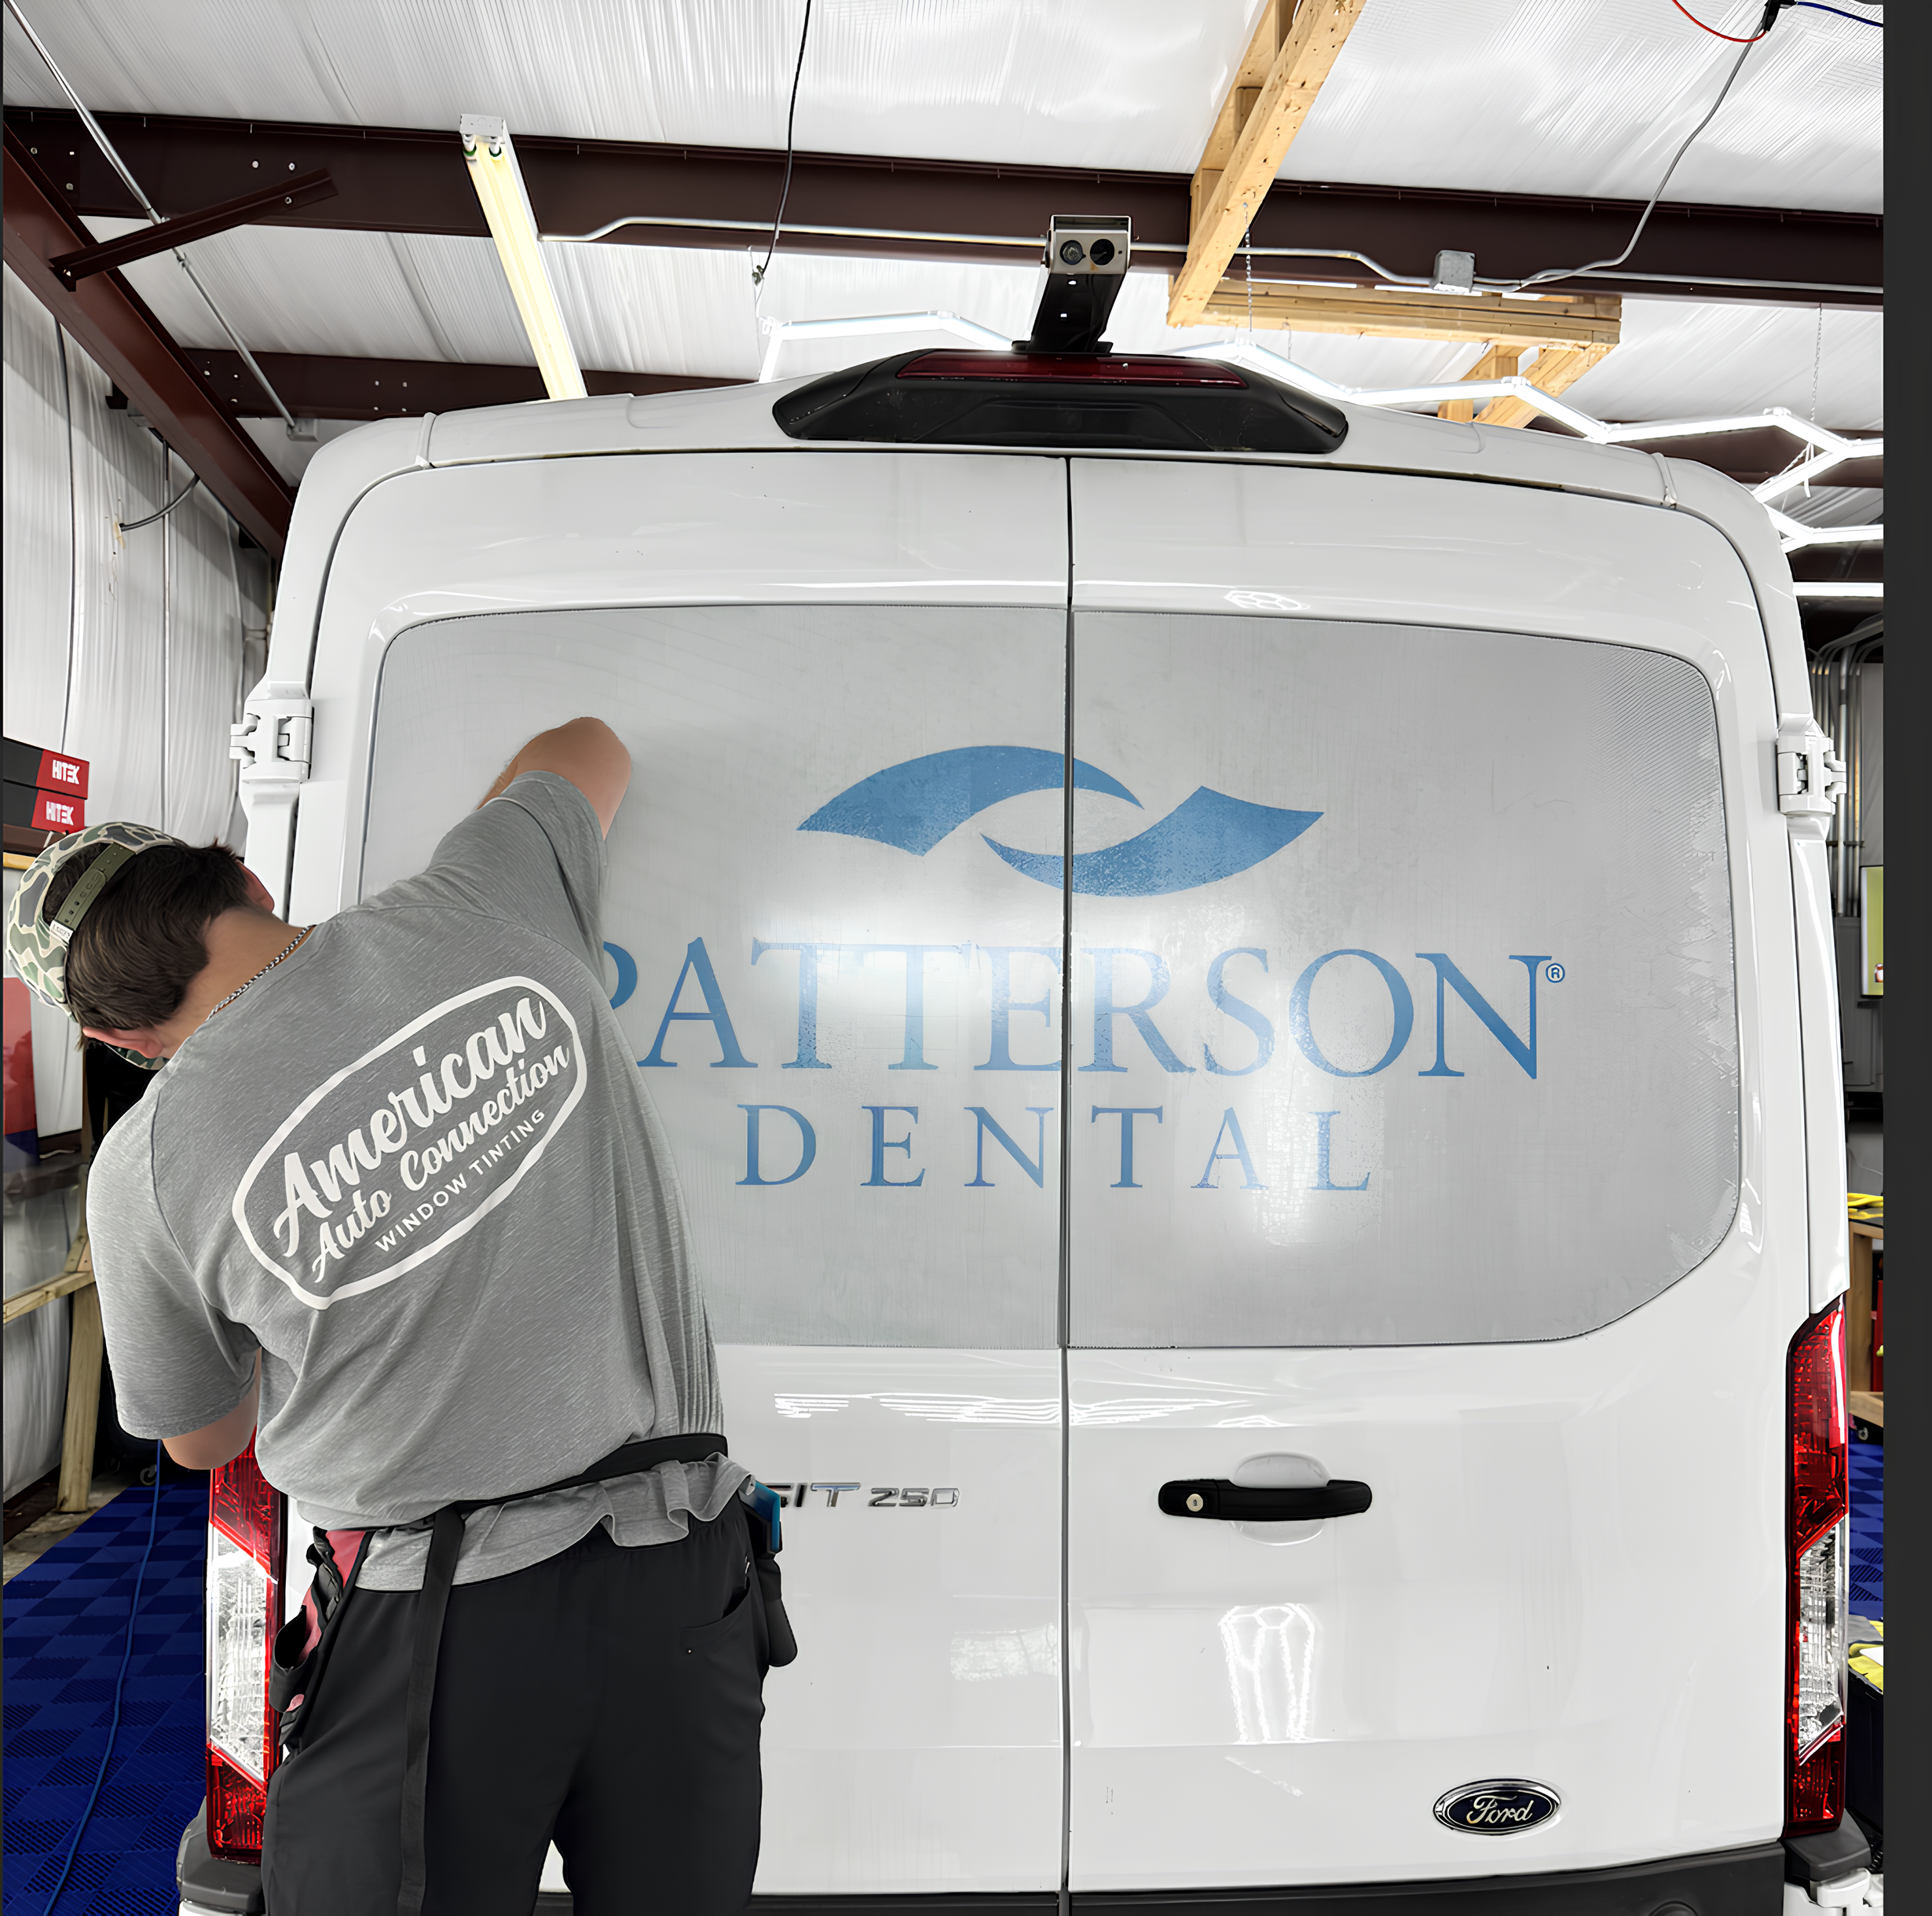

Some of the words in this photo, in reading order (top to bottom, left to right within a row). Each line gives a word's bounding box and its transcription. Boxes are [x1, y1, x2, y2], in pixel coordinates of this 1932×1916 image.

[52, 759, 80, 784] HITEK
[46, 800, 75, 826] HITEK
[273, 997, 547, 1258] American
[735, 1103, 1371, 1191] DENTAL
[311, 1189, 392, 1284] Auto
[400, 1044, 570, 1191] Connection
[375, 1173, 467, 1252] WINDOW
[469, 1109, 546, 1176] TINTING
[868, 1487, 960, 1508] 250
[1465, 1795, 1535, 1824] Ford
